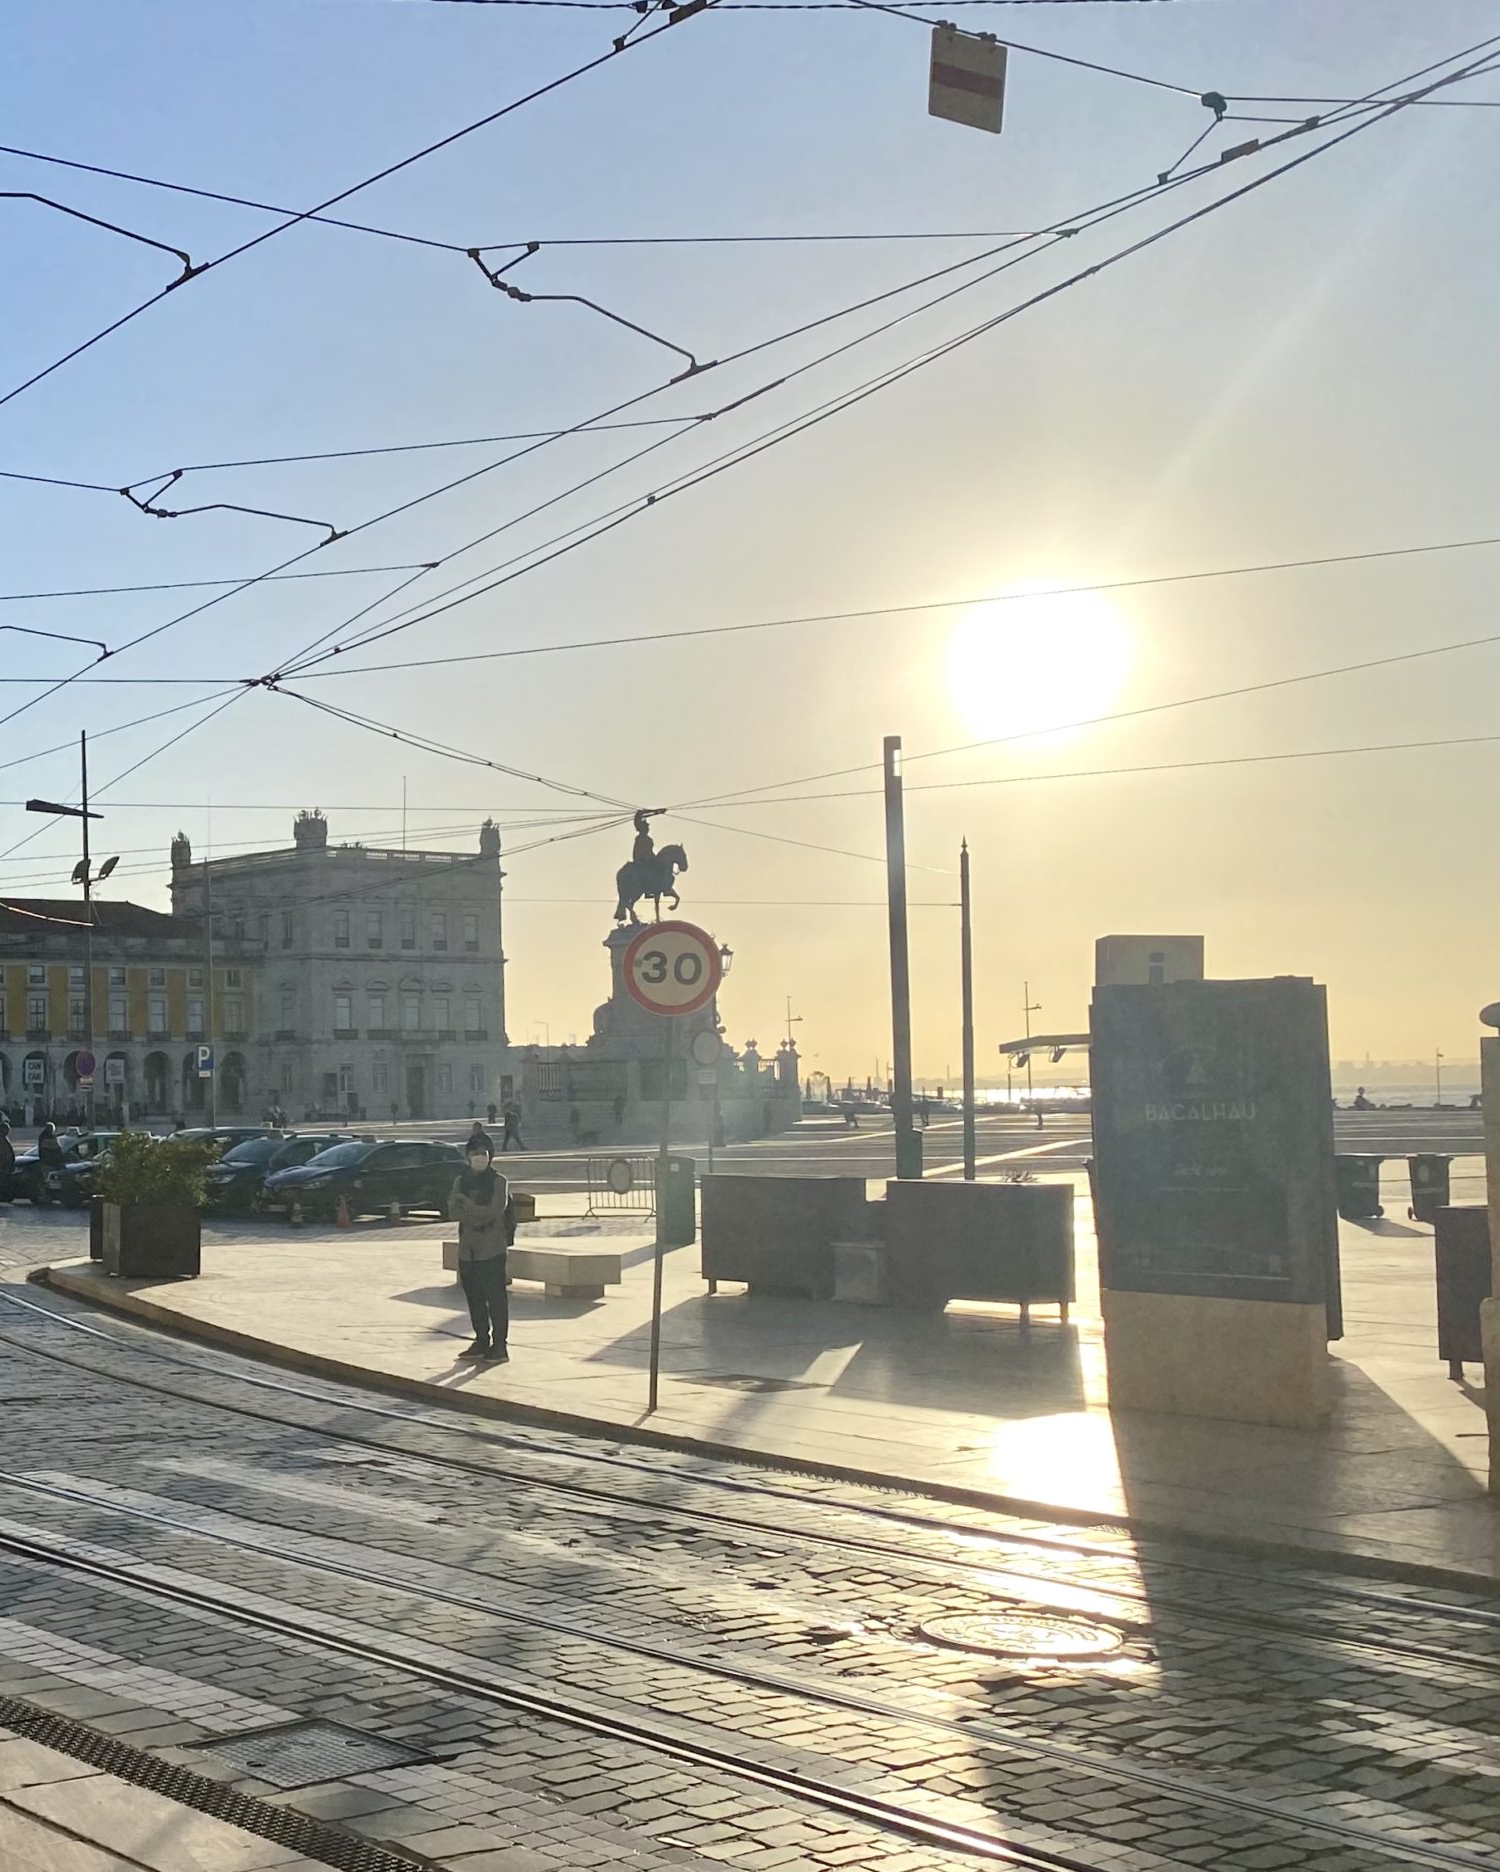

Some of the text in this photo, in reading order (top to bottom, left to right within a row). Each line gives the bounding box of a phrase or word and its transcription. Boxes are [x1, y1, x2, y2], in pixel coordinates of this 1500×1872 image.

[641, 951, 702, 985] 30
[198, 1046, 210, 1068] P
[1145, 1102, 1256, 1121] BACALHAU
